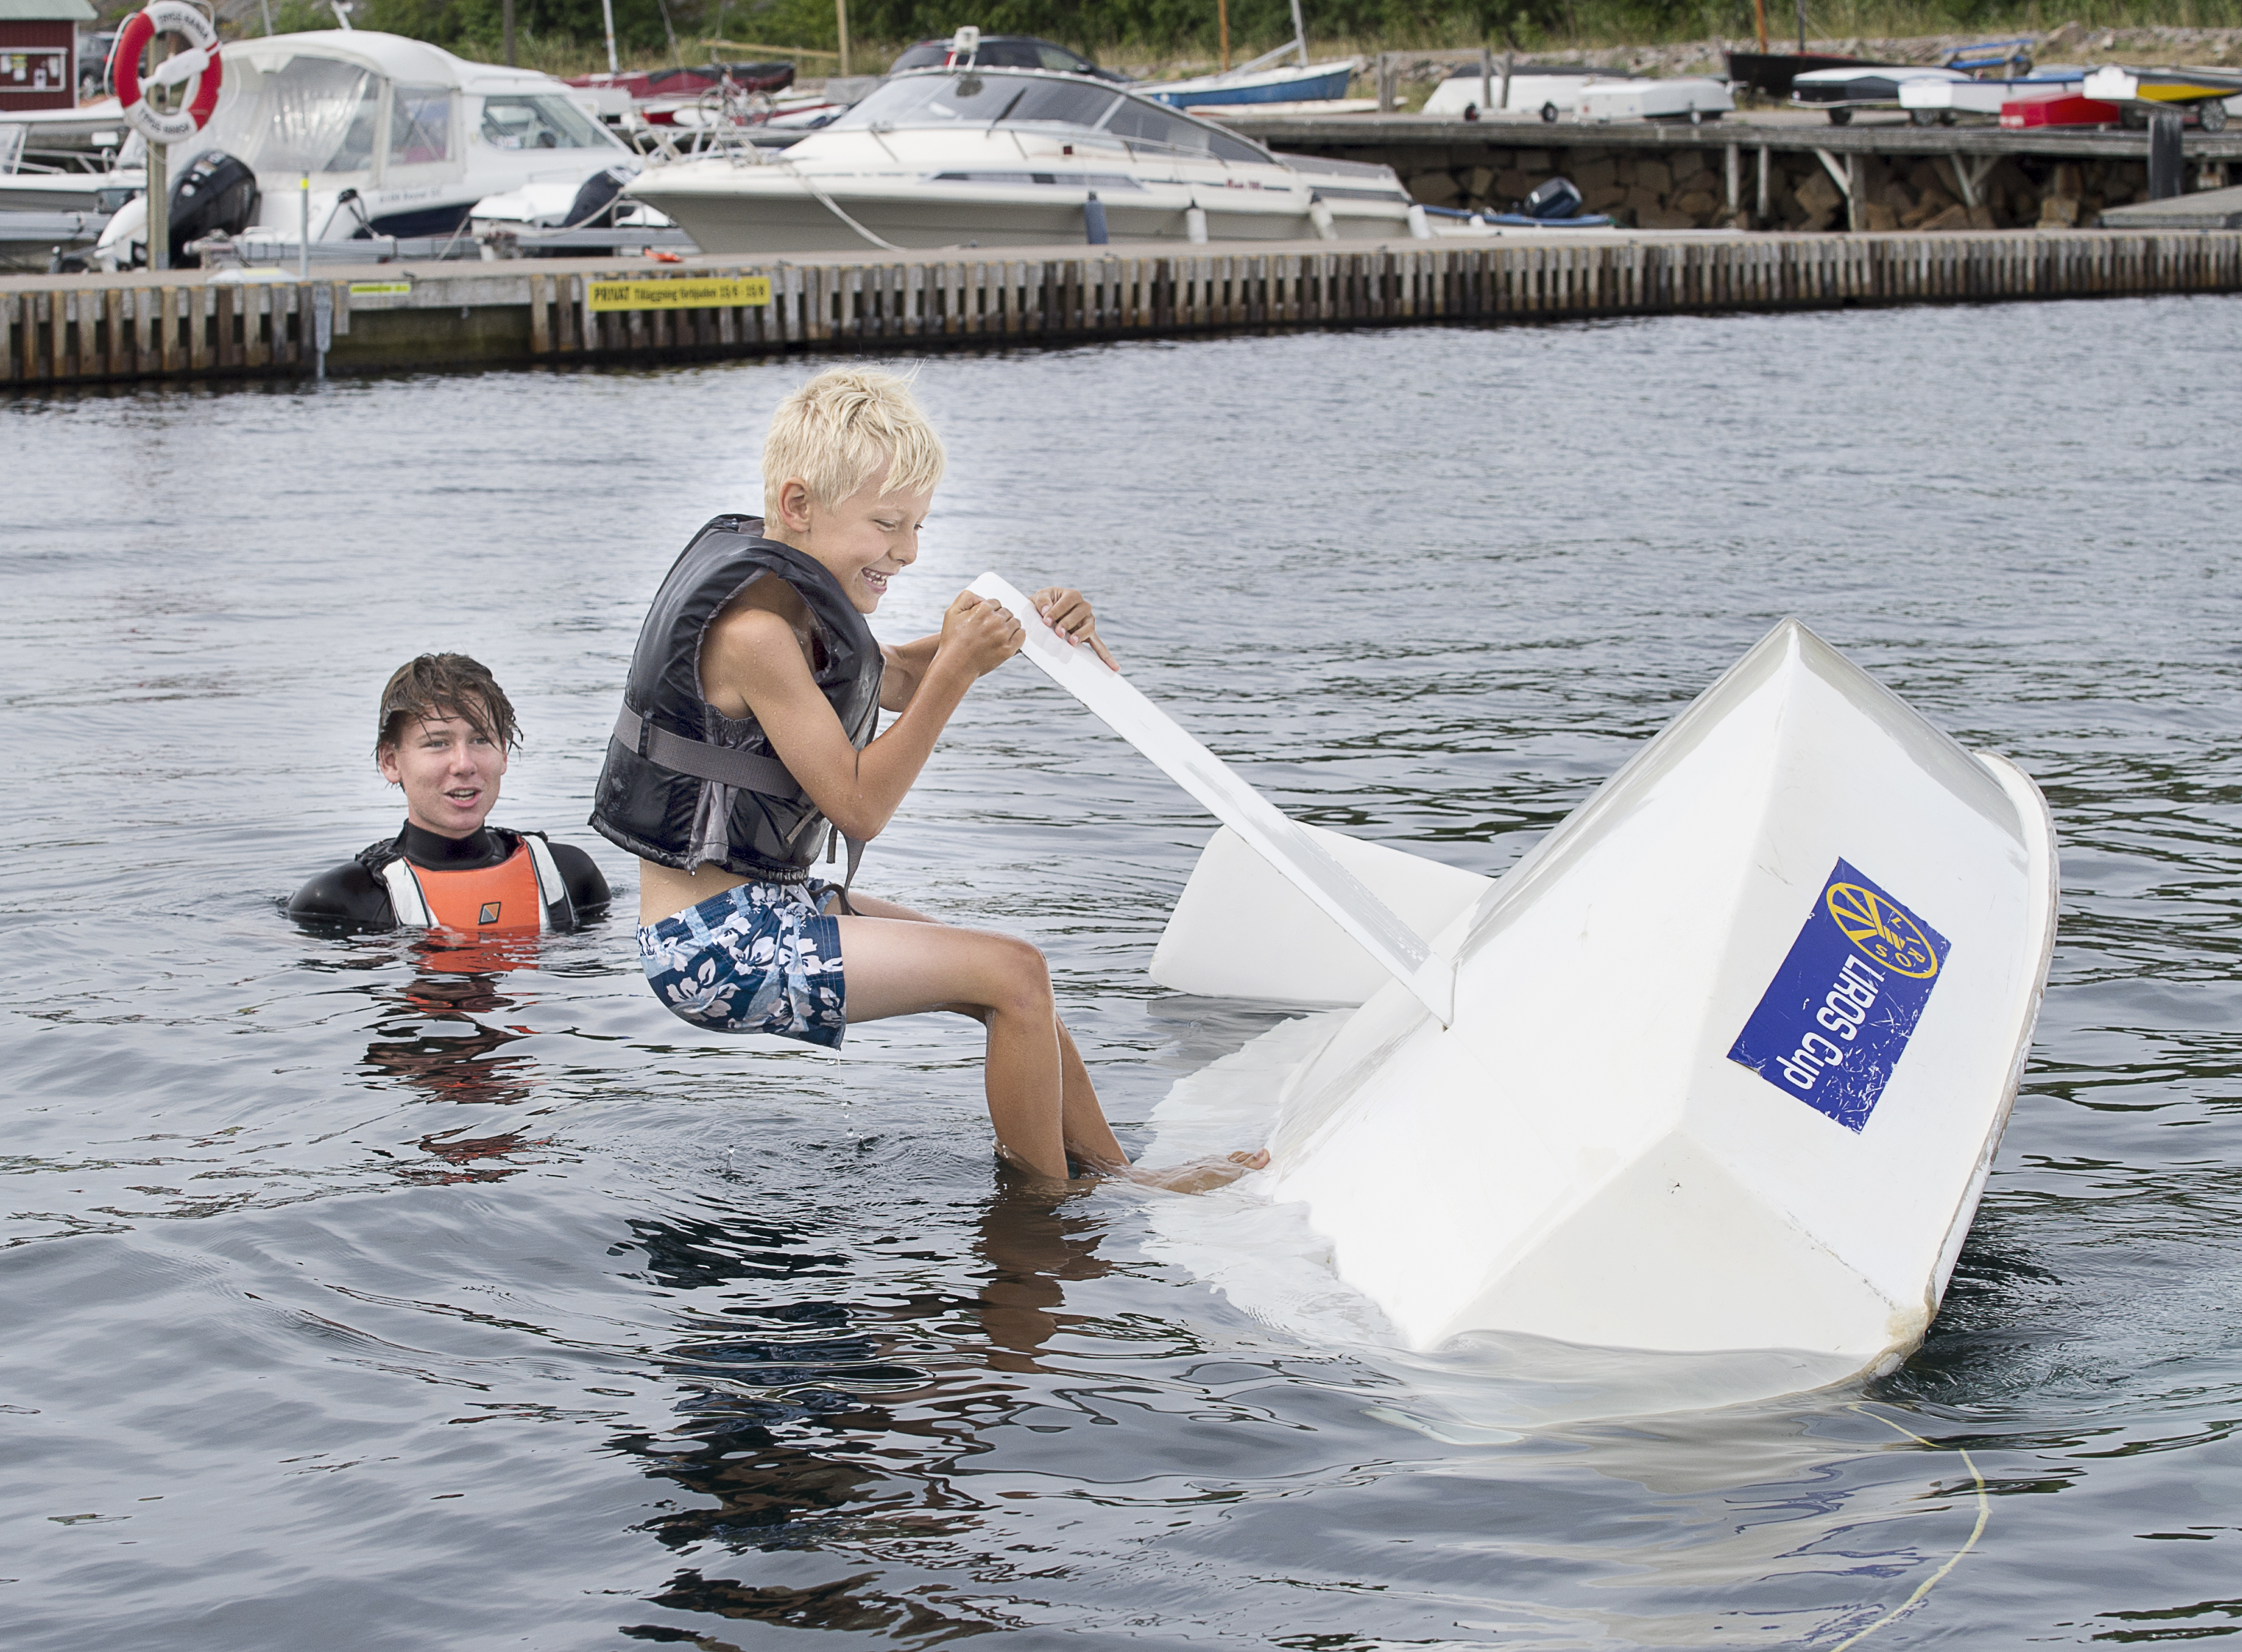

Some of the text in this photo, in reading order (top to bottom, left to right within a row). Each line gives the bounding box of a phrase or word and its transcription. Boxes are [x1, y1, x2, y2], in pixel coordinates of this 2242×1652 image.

[594, 285, 629, 301] PRIVAT
[1874, 916, 1927, 969] LIROS
[1775, 953, 1885, 1090] LIROS Cup
